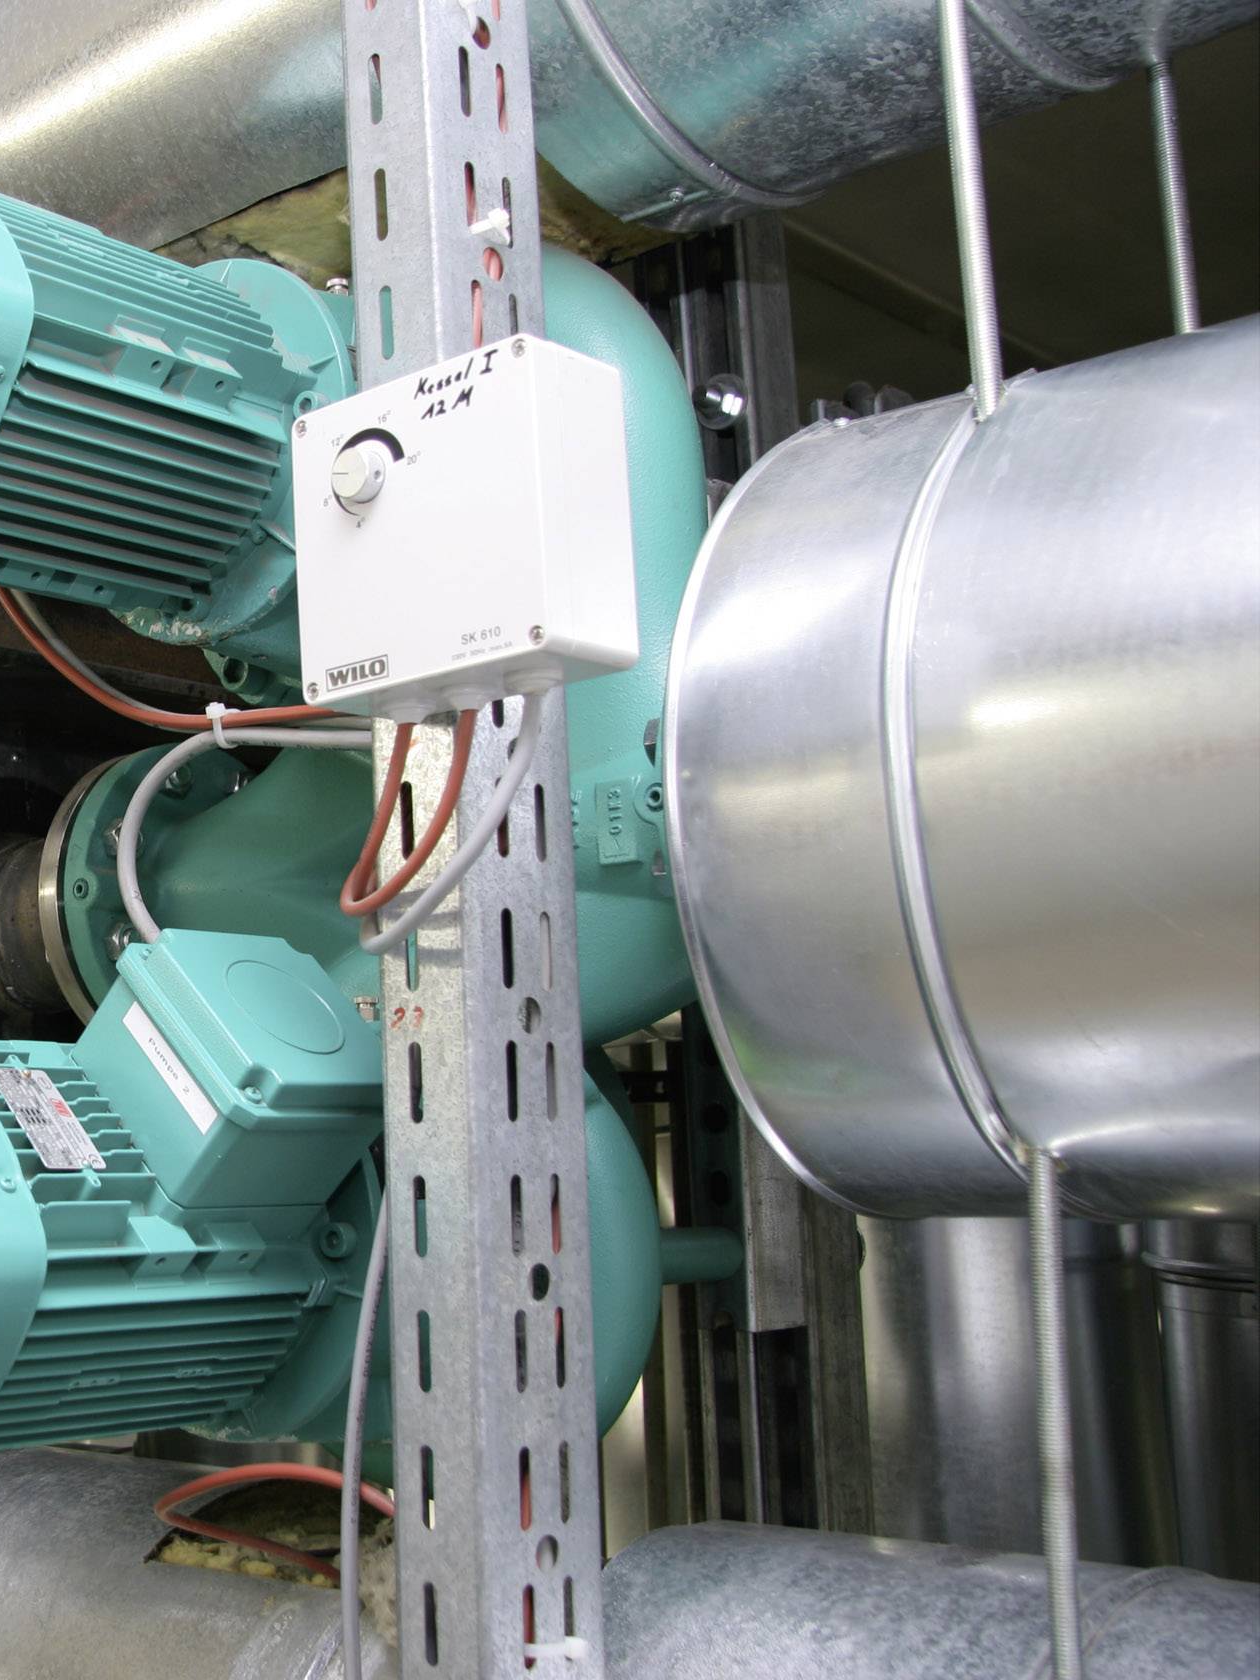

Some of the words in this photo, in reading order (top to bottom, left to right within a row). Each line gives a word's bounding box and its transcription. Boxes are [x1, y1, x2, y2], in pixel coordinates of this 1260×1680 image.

[460, 632, 478, 646] SK
[480, 625, 502, 641] 610
[327, 658, 387, 688] WILO
[147, 1037, 180, 1080] Pumpe
[181, 1085, 191, 1095] 2
